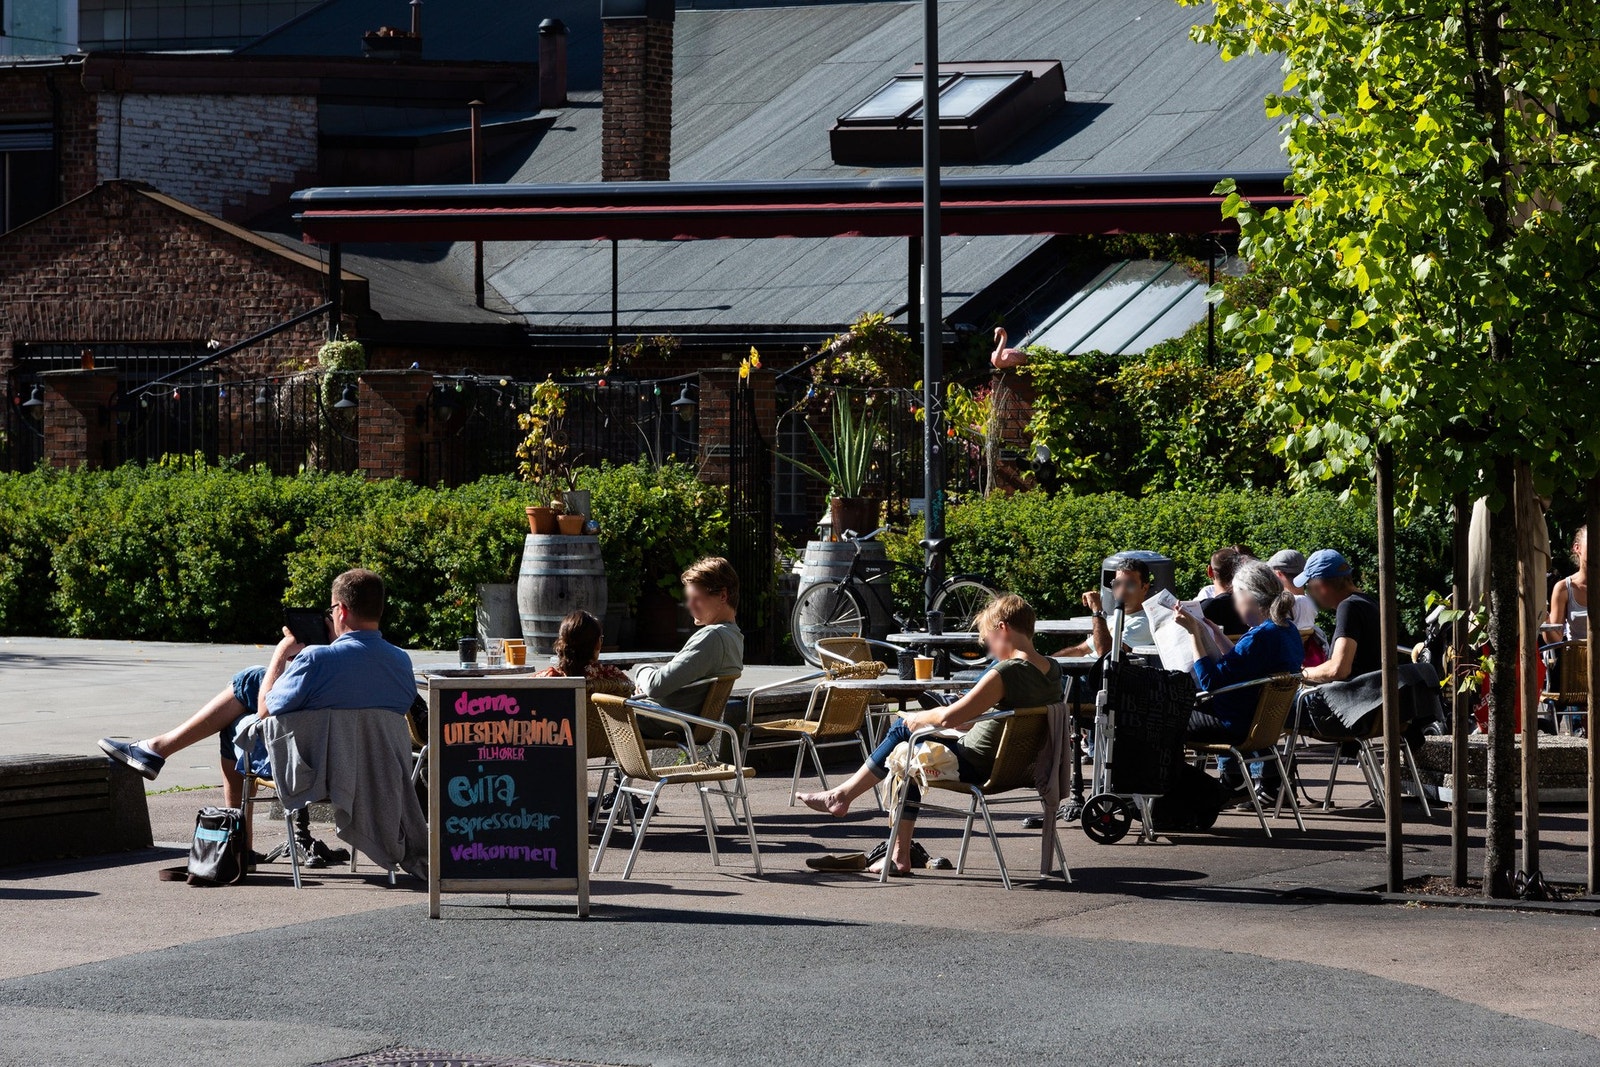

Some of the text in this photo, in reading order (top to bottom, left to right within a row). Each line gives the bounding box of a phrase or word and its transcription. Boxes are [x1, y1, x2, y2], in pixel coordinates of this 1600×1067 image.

[455, 691, 520, 715] denne
[477, 746, 525, 760] TILHØRER
[445, 808, 560, 841] espressobar
[450, 843, 558, 870] velkommen
